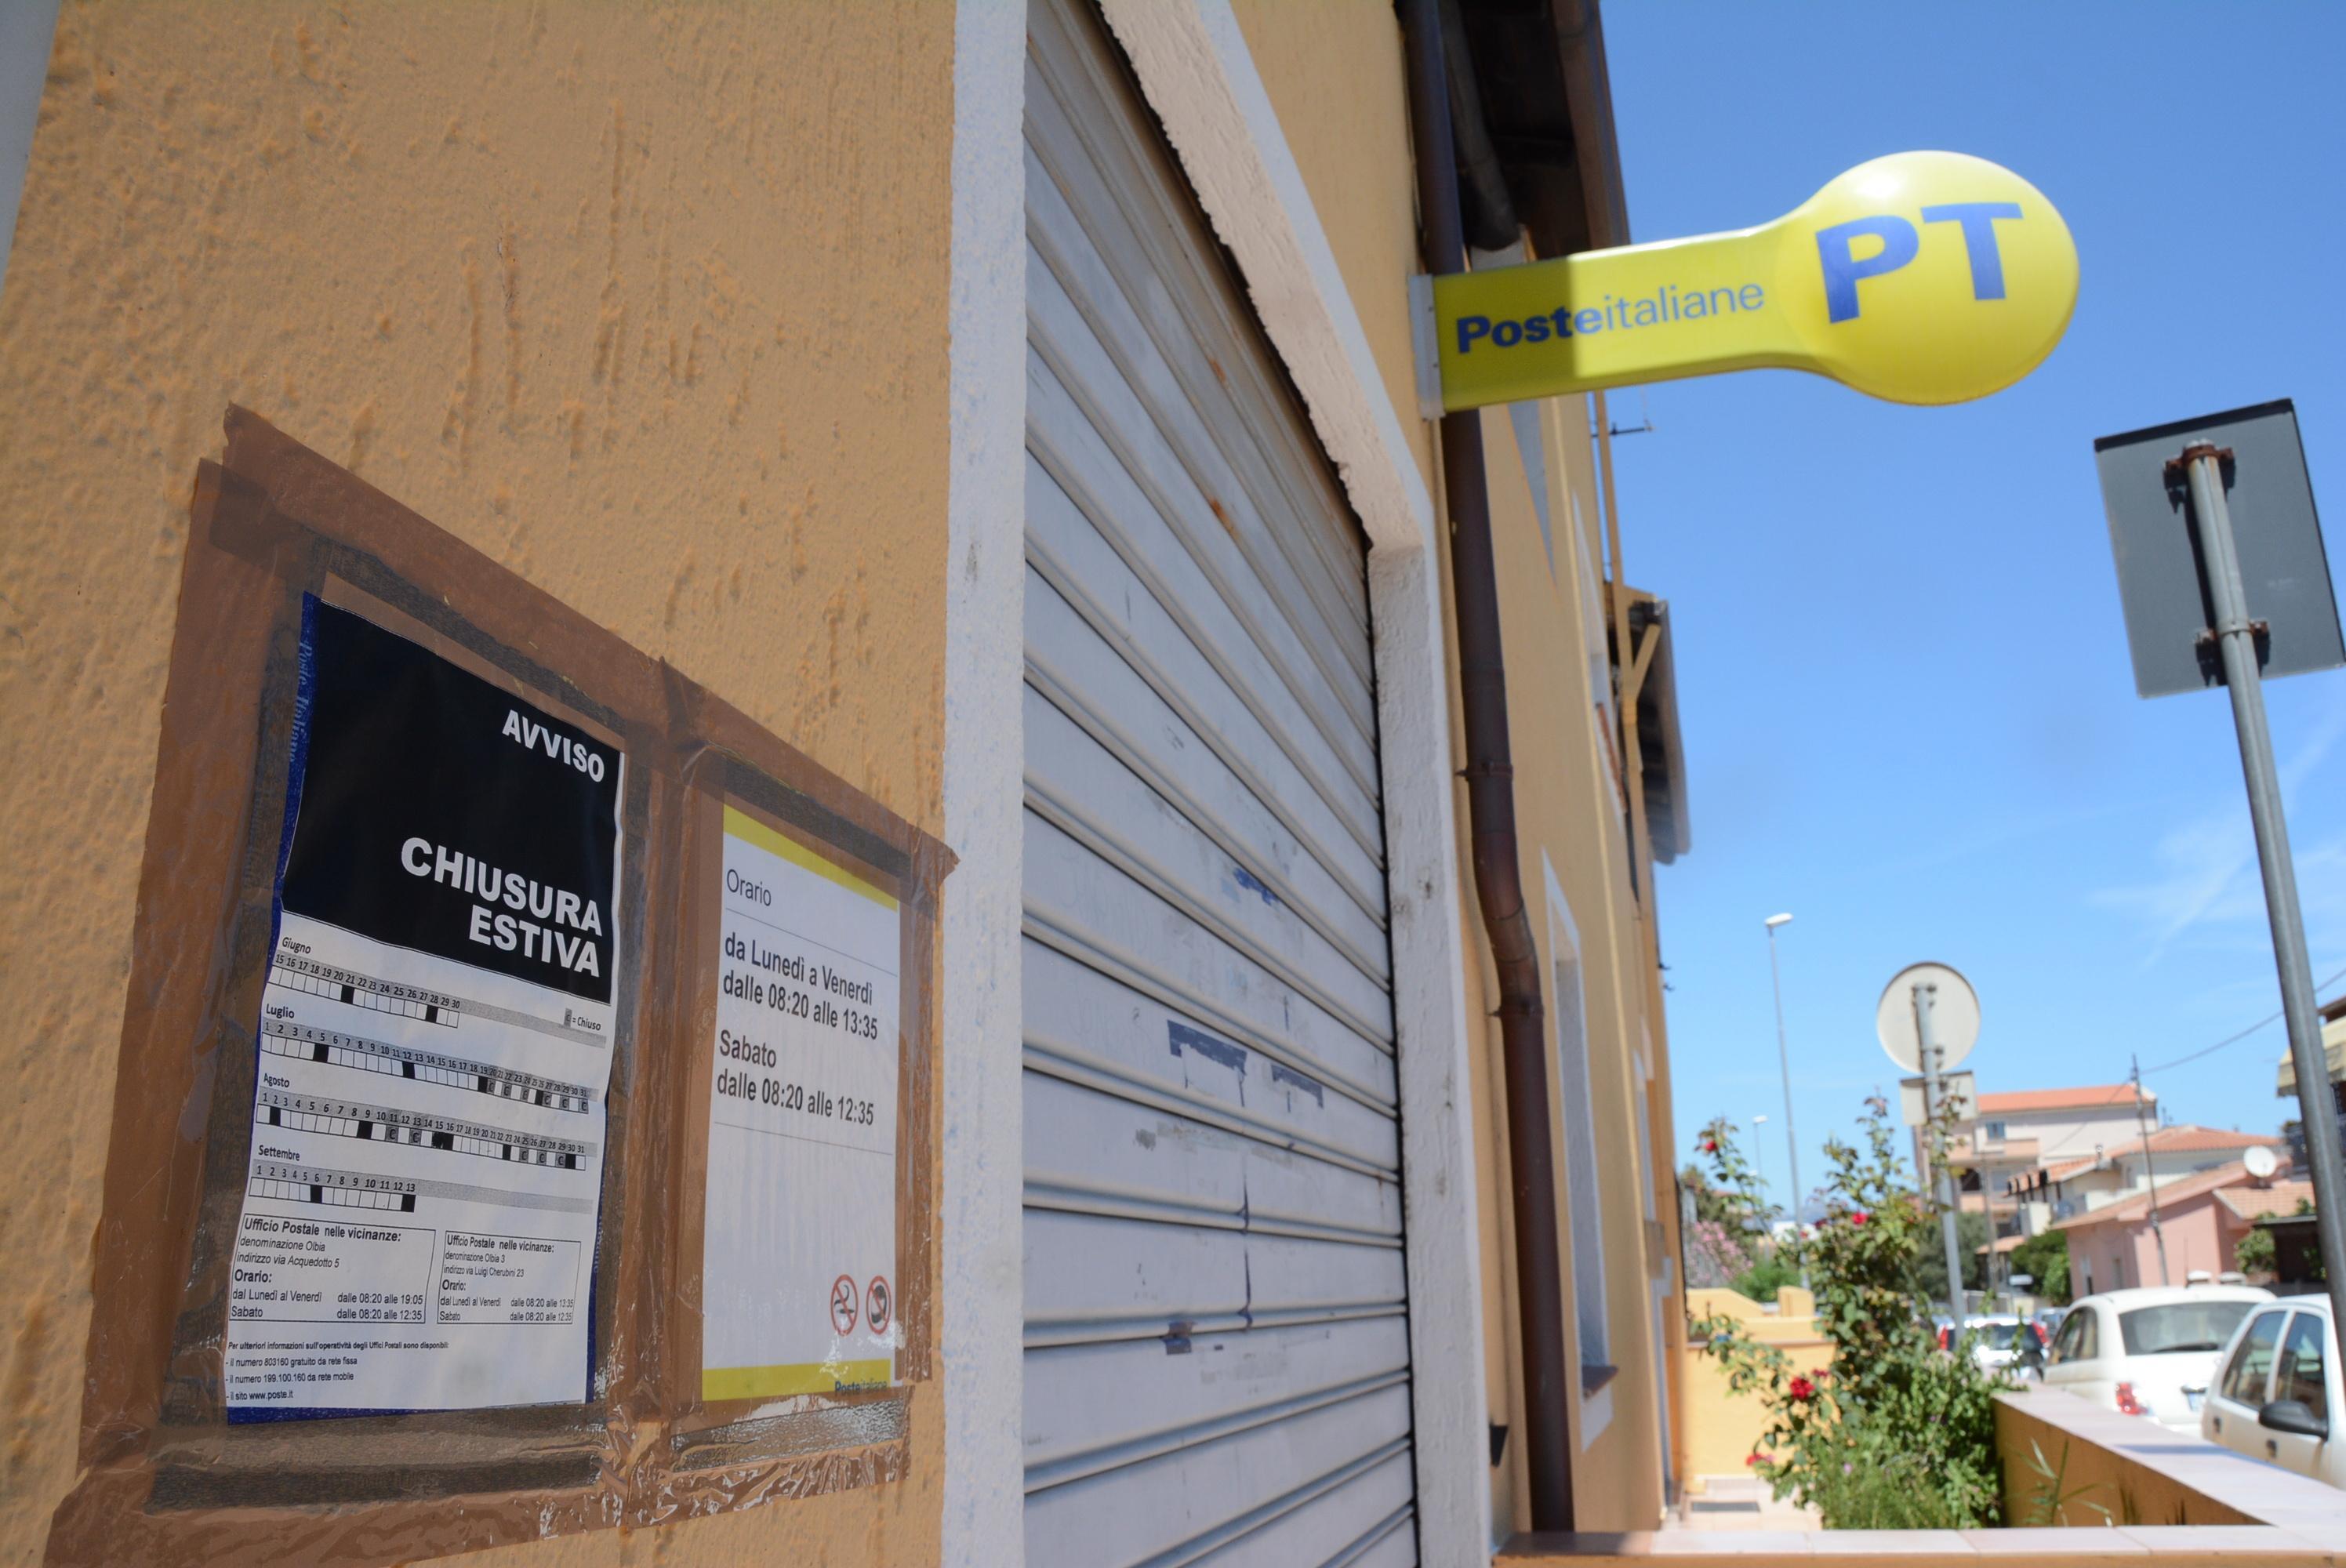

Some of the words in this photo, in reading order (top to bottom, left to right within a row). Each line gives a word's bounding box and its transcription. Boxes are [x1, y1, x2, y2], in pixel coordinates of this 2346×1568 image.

[1815, 201, 2024, 325] PT
[1456, 283, 1764, 354] Posteitaliane
[502, 710, 605, 782] AVVISO
[401, 837, 603, 937] CHIUSURA
[727, 869, 772, 907] Orario
[281, 937, 311, 954] Giugno
[469, 904, 600, 978] ESTIVA
[725, 931, 746, 961] da
[751, 939, 804, 982] Lunedì
[809, 967, 817, 986] a
[822, 965, 873, 1006] Venerdì
[275, 954, 284, 964] 15
[287, 957, 296, 967] 16
[299, 960, 308, 971] 17
[310, 964, 320, 975] 18
[322, 967, 332, 978] 19
[333, 971, 343, 981] 20
[346, 974, 354, 985] 21
[358, 978, 367, 987] 22
[369, 981, 377, 990] 23
[380, 983, 390, 993] 24
[394, 986, 404, 996] 25
[408, 989, 417, 999] 26
[419, 992, 428, 1001] 27
[430, 994, 439, 1004] 28
[441, 996, 450, 1007] 29
[452, 999, 460, 1009] 30
[266, 1004, 295, 1019] Luglio
[723, 970, 763, 1004] dalle
[768, 982, 808, 1019] 08:20
[813, 1001, 838, 1028] alle
[842, 1007, 877, 1040] 13:35
[577, 1016, 601, 1031] Chiuso
[265, 1022, 270, 1031] 1
[277, 1024, 284, 1034] 2
[292, 1027, 298, 1036] 3
[307, 1029, 312, 1040] 4
[320, 1033, 325, 1041] 5
[333, 1035, 339, 1044] 6
[346, 1038, 351, 1047] 7
[358, 1040, 363, 1050] 8
[370, 1043, 376, 1051] 9
[381, 1046, 390, 1054] 10
[719, 1029, 777, 1069] Sabato
[263, 1073, 290, 1088] Agosto
[263, 1093, 267, 1102] 1
[274, 1095, 278, 1105] 2
[283, 1098, 288, 1107] 3
[295, 1099, 301, 1109] 4
[309, 1102, 315, 1111] 5
[324, 1104, 329, 1112] 6
[338, 1105, 343, 1115] 7
[351, 1108, 358, 1116] 8
[717, 1069, 757, 1101] dalle
[761, 1077, 803, 1111] 08:20
[808, 1091, 833, 1118] alle
[837, 1094, 874, 1127] 12:35
[258, 1145, 300, 1162] Settembre
[257, 1165, 262, 1174] 1
[270, 1167, 275, 1177] 2
[282, 1168, 287, 1178] 3
[292, 1171, 297, 1179] 4
[303, 1172, 307, 1181] 5
[314, 1173, 320, 1182] 6
[327, 1174, 332, 1184] 7
[339, 1176, 345, 1185] 8
[353, 1178, 358, 1186] 9
[365, 1178, 376, 1188] 10
[380, 1180, 390, 1189] 11
[394, 1181, 403, 1191] 12
[406, 1183, 416, 1192] 13
[245, 1218, 279, 1232] Ufficio
[281, 1221, 320, 1236] Postale
[325, 1225, 346, 1238] nelle
[347, 1227, 401, 1242] vicinanze:
[240, 1236, 304, 1250] denominazione
[305, 1240, 326, 1252] Olbia
[447, 1234, 469, 1247] Ufficio
[470, 1236, 496, 1249] Postale
[499, 1240, 518, 1251] nelle
[519, 1240, 554, 1254] vicinanze:
[237, 1251, 271, 1264] indirizzo
[274, 1254, 286, 1265] via
[288, 1255, 333, 1269] Acquedotto
[334, 1258, 340, 1269] 5
[445, 1250, 484, 1263] denominazione
[485, 1253, 500, 1263] Olbia
[500, 1254, 506, 1264] 3
[234, 1269, 272, 1283] Orario:
[474, 1266, 488, 1278] Luigi
[489, 1267, 516, 1277] Cherubini
[232, 1288, 246, 1300] dal
[279, 1290, 288, 1301] al
[337, 1292, 357, 1303] dalle
[359, 1293, 382, 1304] 08:20
[384, 1294, 398, 1305] alle
[401, 1294, 423, 1305] 19:05
[440, 1296, 452, 1306] dal
[472, 1298, 478, 1307] al
[510, 1298, 525, 1308] dalle
[525, 1298, 544, 1308] 08:20
[546, 1298, 557, 1308] alle
[231, 1305, 263, 1318] Sabato
[336, 1308, 357, 1319] dalle
[358, 1308, 382, 1319] 08:20
[383, 1309, 398, 1319] alle
[400, 1309, 423, 1320] 12:35
[439, 1311, 461, 1321] Sabato
[510, 1312, 524, 1321] dalle
[525, 1312, 544, 1321] 08:20
[545, 1312, 556, 1321] alle
[290, 1358, 316, 1368] gratuito
[318, 1357, 327, 1366] da
[343, 1356, 358, 1365] fissa
[307, 1373, 316, 1381] da
[332, 1372, 354, 1381] mobile
[235, 1392, 248, 1400] sito
[249, 1389, 293, 1402] www.poste.it
